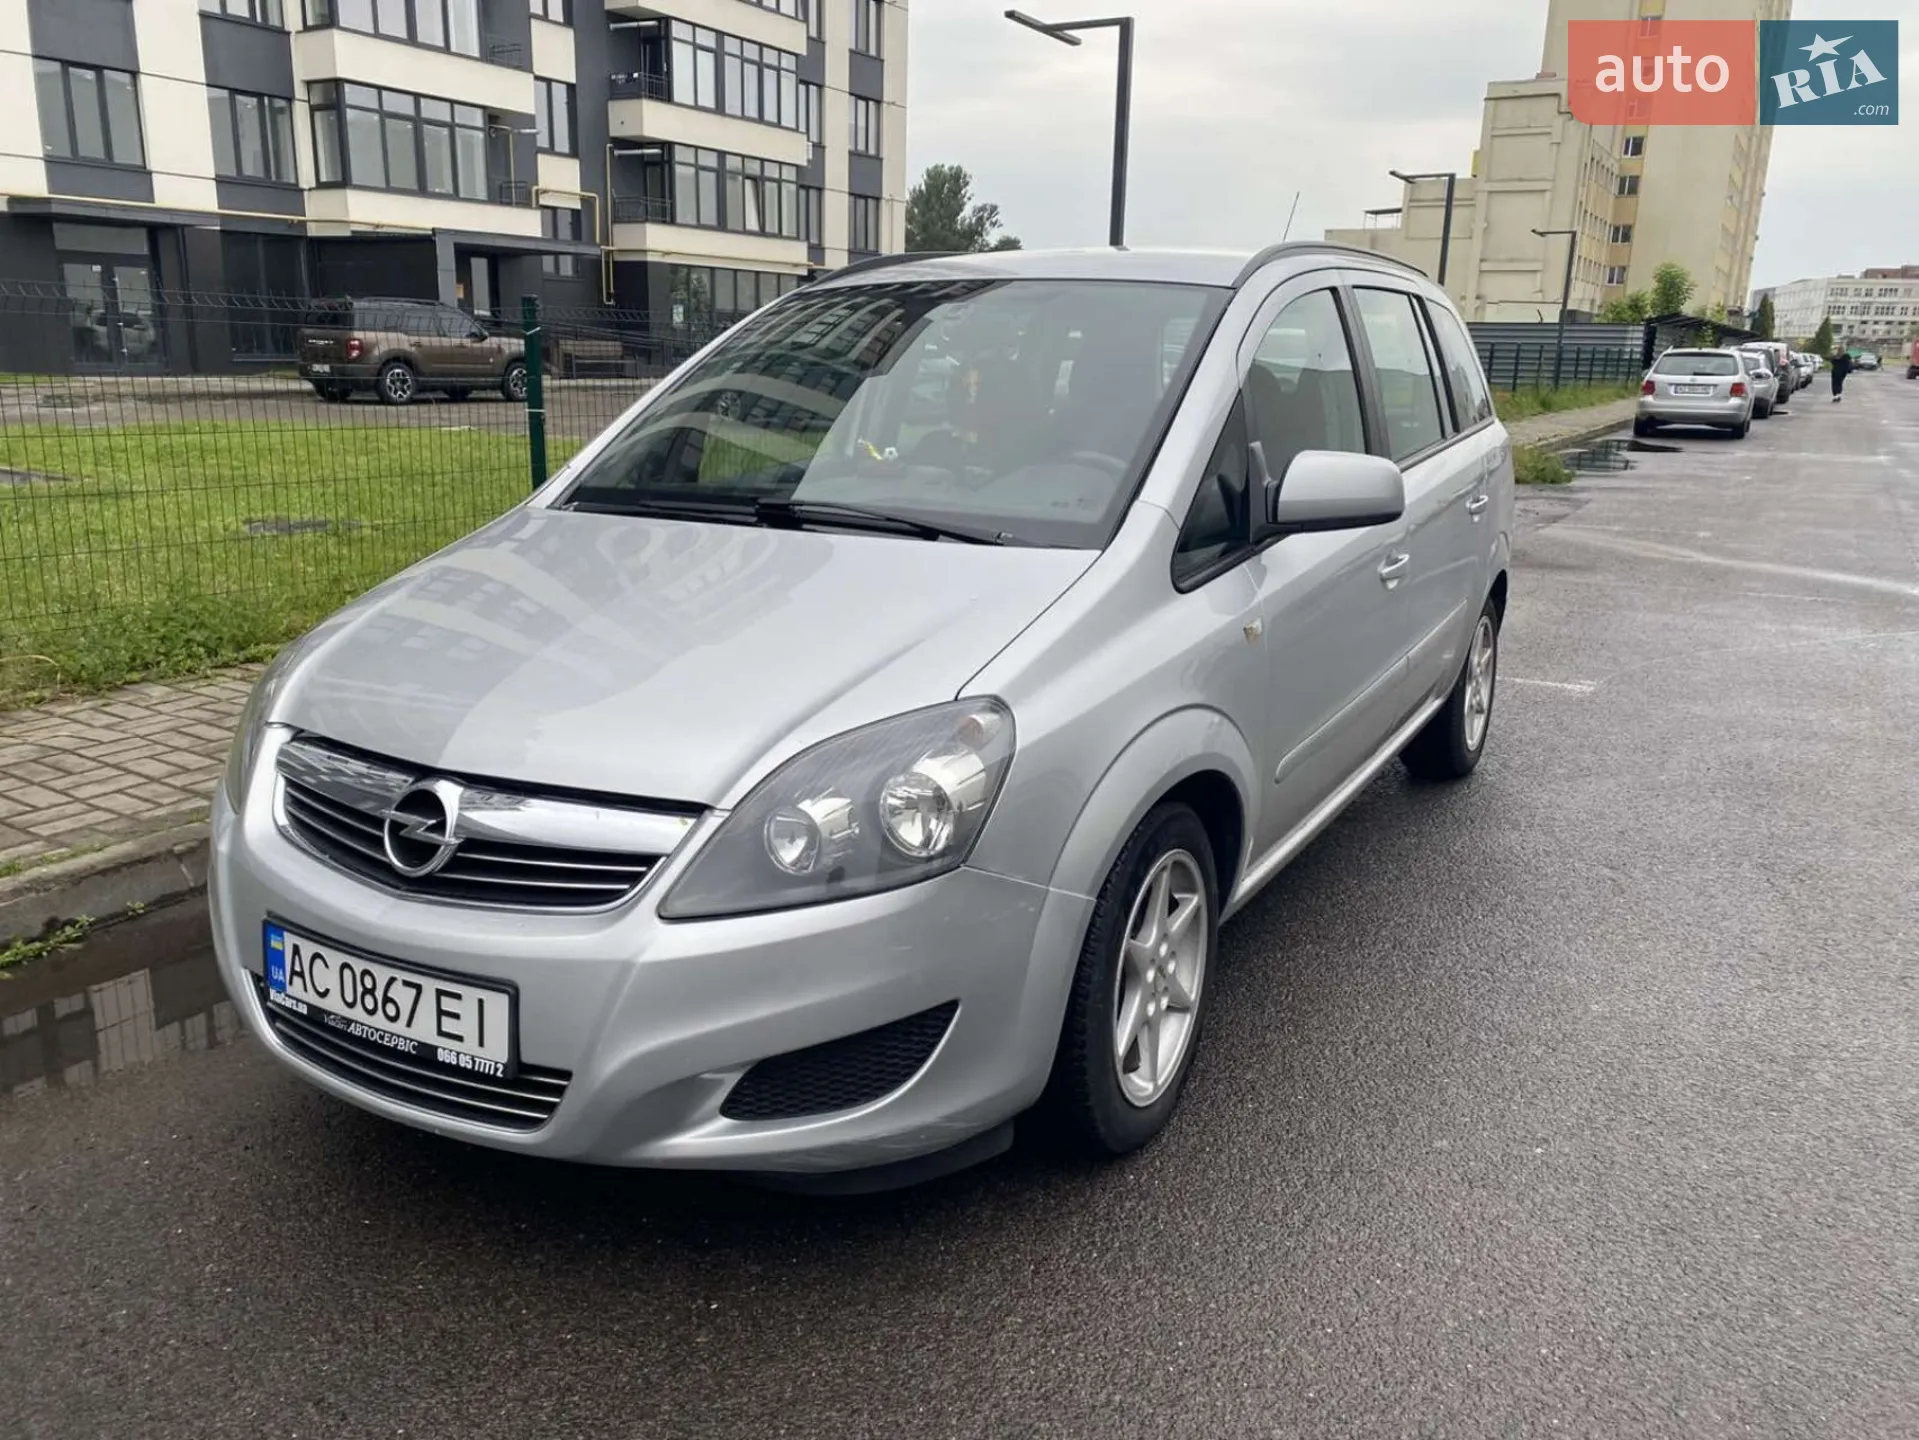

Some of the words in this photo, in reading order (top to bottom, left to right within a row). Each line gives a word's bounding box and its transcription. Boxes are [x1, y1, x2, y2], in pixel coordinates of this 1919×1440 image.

[271, 965, 285, 983] UA
[288, 943, 331, 999] AC
[339, 961, 423, 1028] 0867
[434, 987, 485, 1048] EI
[347, 1022, 418, 1054] АВТОСЕРВІС
[437, 1047, 457, 1065] 066
[458, 1053, 473, 1070] 05
